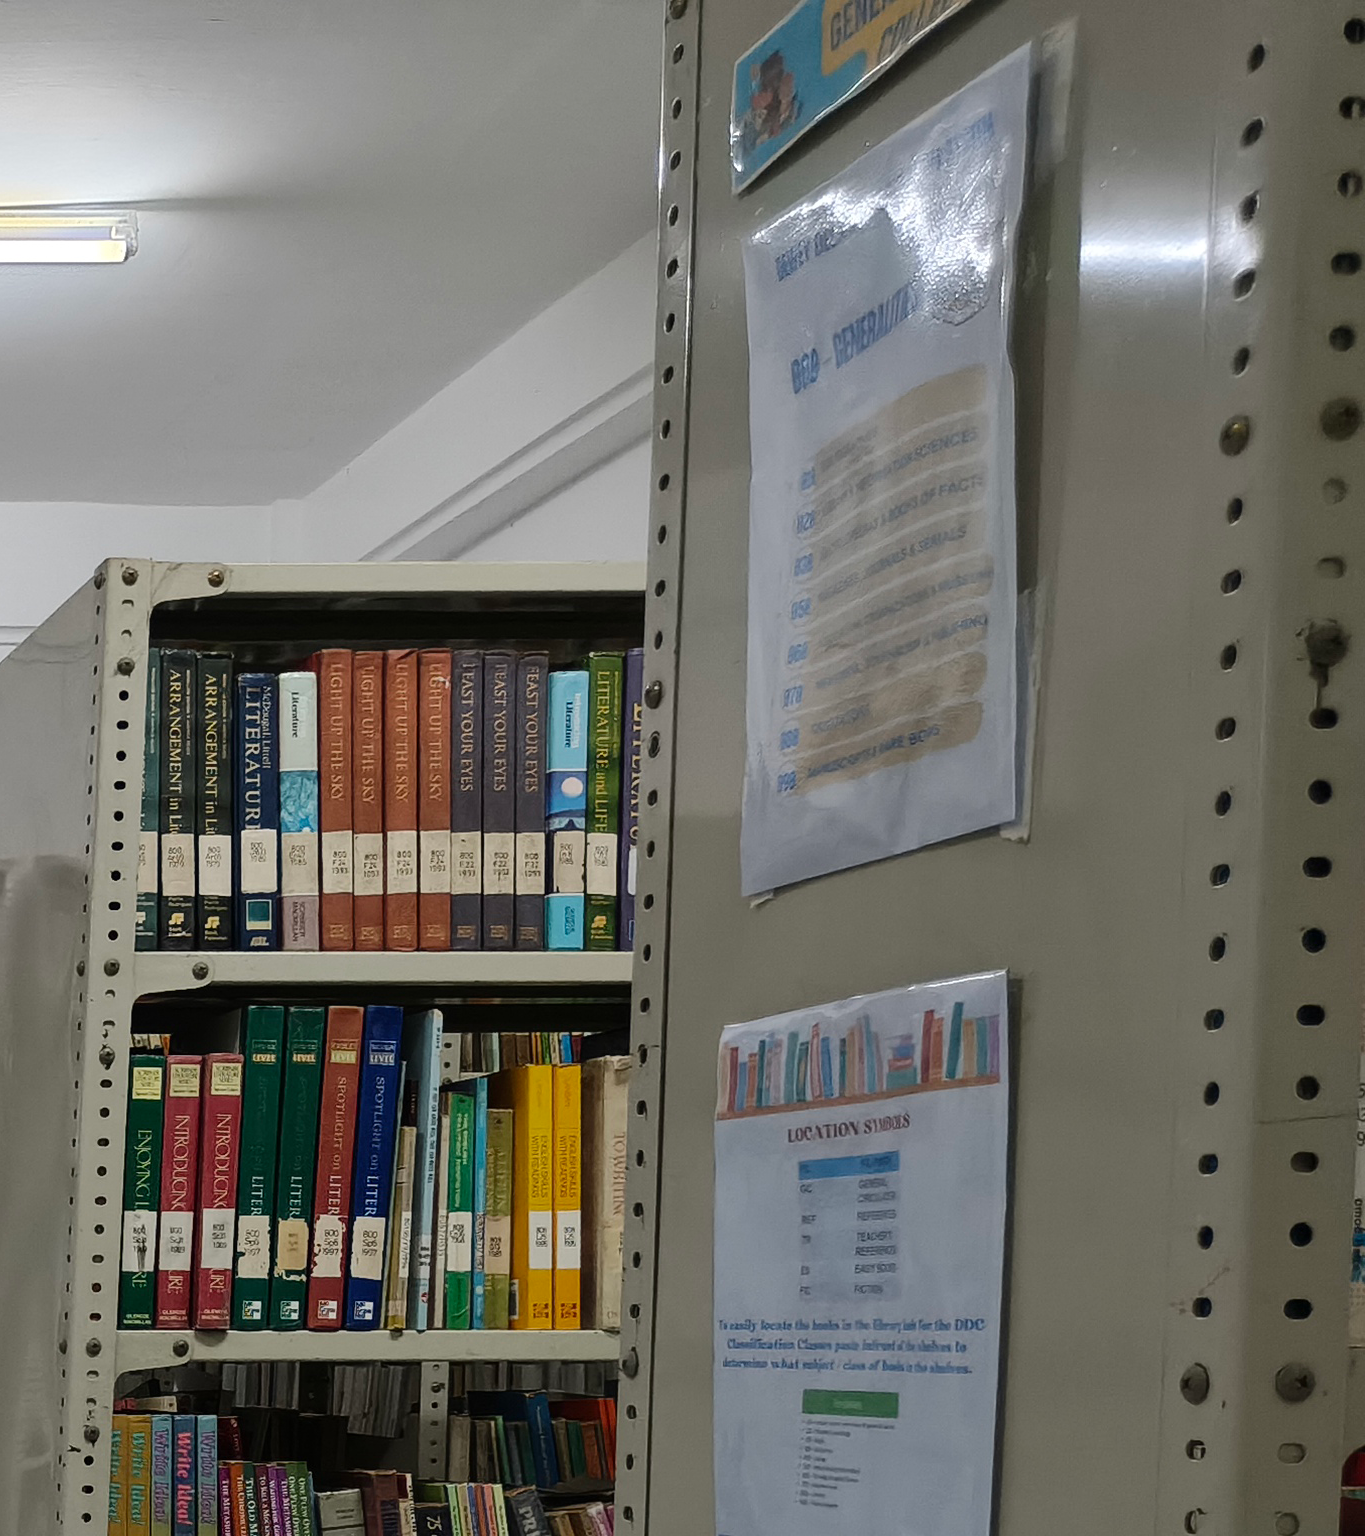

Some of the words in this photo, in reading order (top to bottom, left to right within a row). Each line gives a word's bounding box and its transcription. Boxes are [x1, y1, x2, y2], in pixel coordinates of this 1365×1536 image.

[291, 691, 299, 738] Literature
[329, 717, 343, 736] UP
[395, 717, 409, 736] UP
[429, 716, 442, 735] UP
[595, 671, 611, 770] LITERATURE
[168, 668, 183, 795] ARRANGEMENT
[204, 673, 219, 801] ARRANGEMENT
[460, 710, 474, 756] YOUR
[493, 710, 507, 754] YOUR
[526, 711, 540, 757] YOUR
[331, 738, 343, 777] THE
[396, 739, 410, 779] THE
[429, 738, 442, 778] THE
[331, 782, 345, 801] SKY
[395, 782, 409, 802] SKY
[429, 782, 443, 802] SKY
[461, 760, 474, 792] EYES
[493, 760, 507, 792] EYES
[525, 761, 539, 794] EYES
[597, 772, 609, 794] and
[169, 798, 180, 812] in
[204, 802, 217, 816] in
[361, 784, 375, 804] SKY
[595, 795, 607, 832] LIFE
[333, 1076, 347, 1150] SPOTLIGHT
[371, 1076, 386, 1149] SPOTLIGHT
[787, 1121, 860, 1143] LOCATION
[134, 1130, 153, 1202] ENJOYING
[332, 1152, 342, 1170] on
[369, 1152, 379, 1172] on
[251, 1176, 265, 1216] LITER
[288, 1176, 303, 1220] LITER
[327, 1174, 342, 1216] LITER
[363, 1174, 379, 1216] LITER
[954, 1317, 986, 1331] DDC
[176, 1431, 193, 1480] Write
[245, 1477, 254, 1492] THE
[246, 1493, 257, 1513] OLD
[425, 1515, 441, 1531] 75
